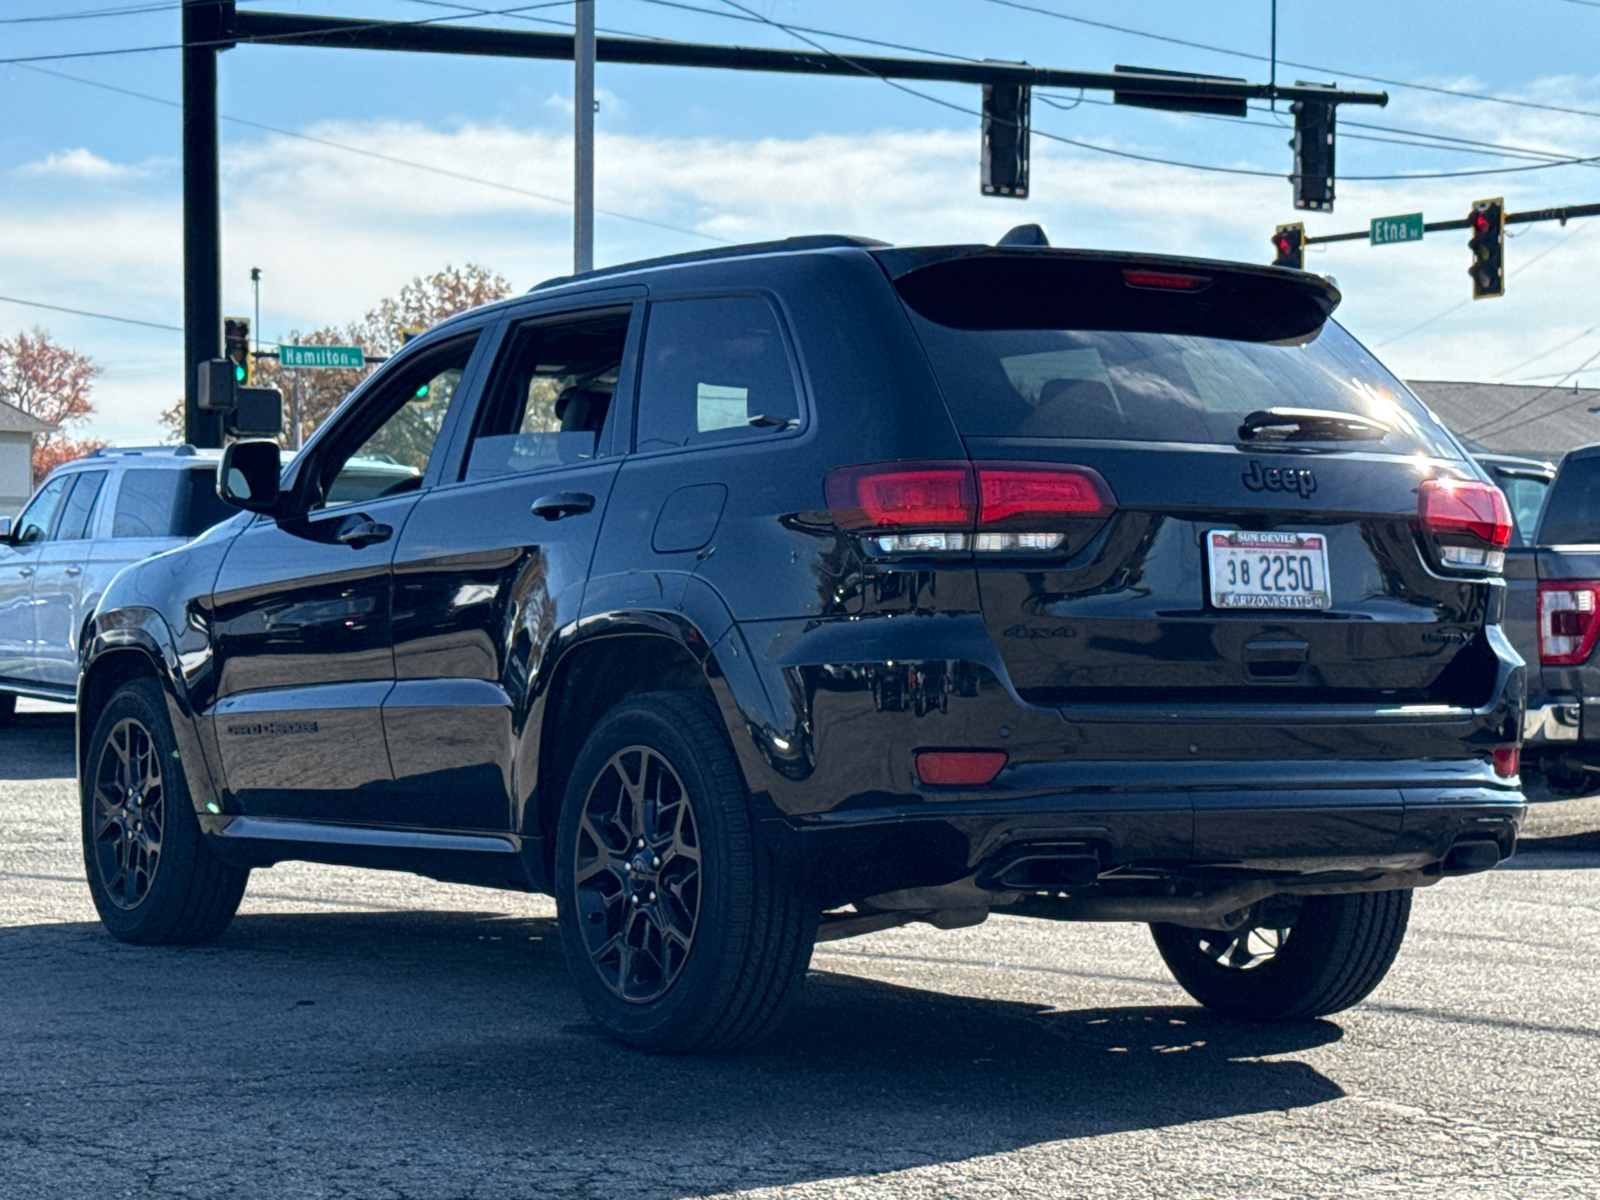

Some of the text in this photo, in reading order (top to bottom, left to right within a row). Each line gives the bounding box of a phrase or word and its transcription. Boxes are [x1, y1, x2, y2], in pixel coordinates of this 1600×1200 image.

[1375, 221, 1407, 241] Etna
[286, 348, 349, 364] Hamilton
[1242, 460, 1316, 499] Jeep
[1237, 533, 1258, 542] SUN
[1260, 533, 1296, 543] DEVILS
[1259, 555, 1314, 592] 2250
[1233, 595, 1278, 607] ARIZONA
[1003, 624, 1077, 638] 4x4
